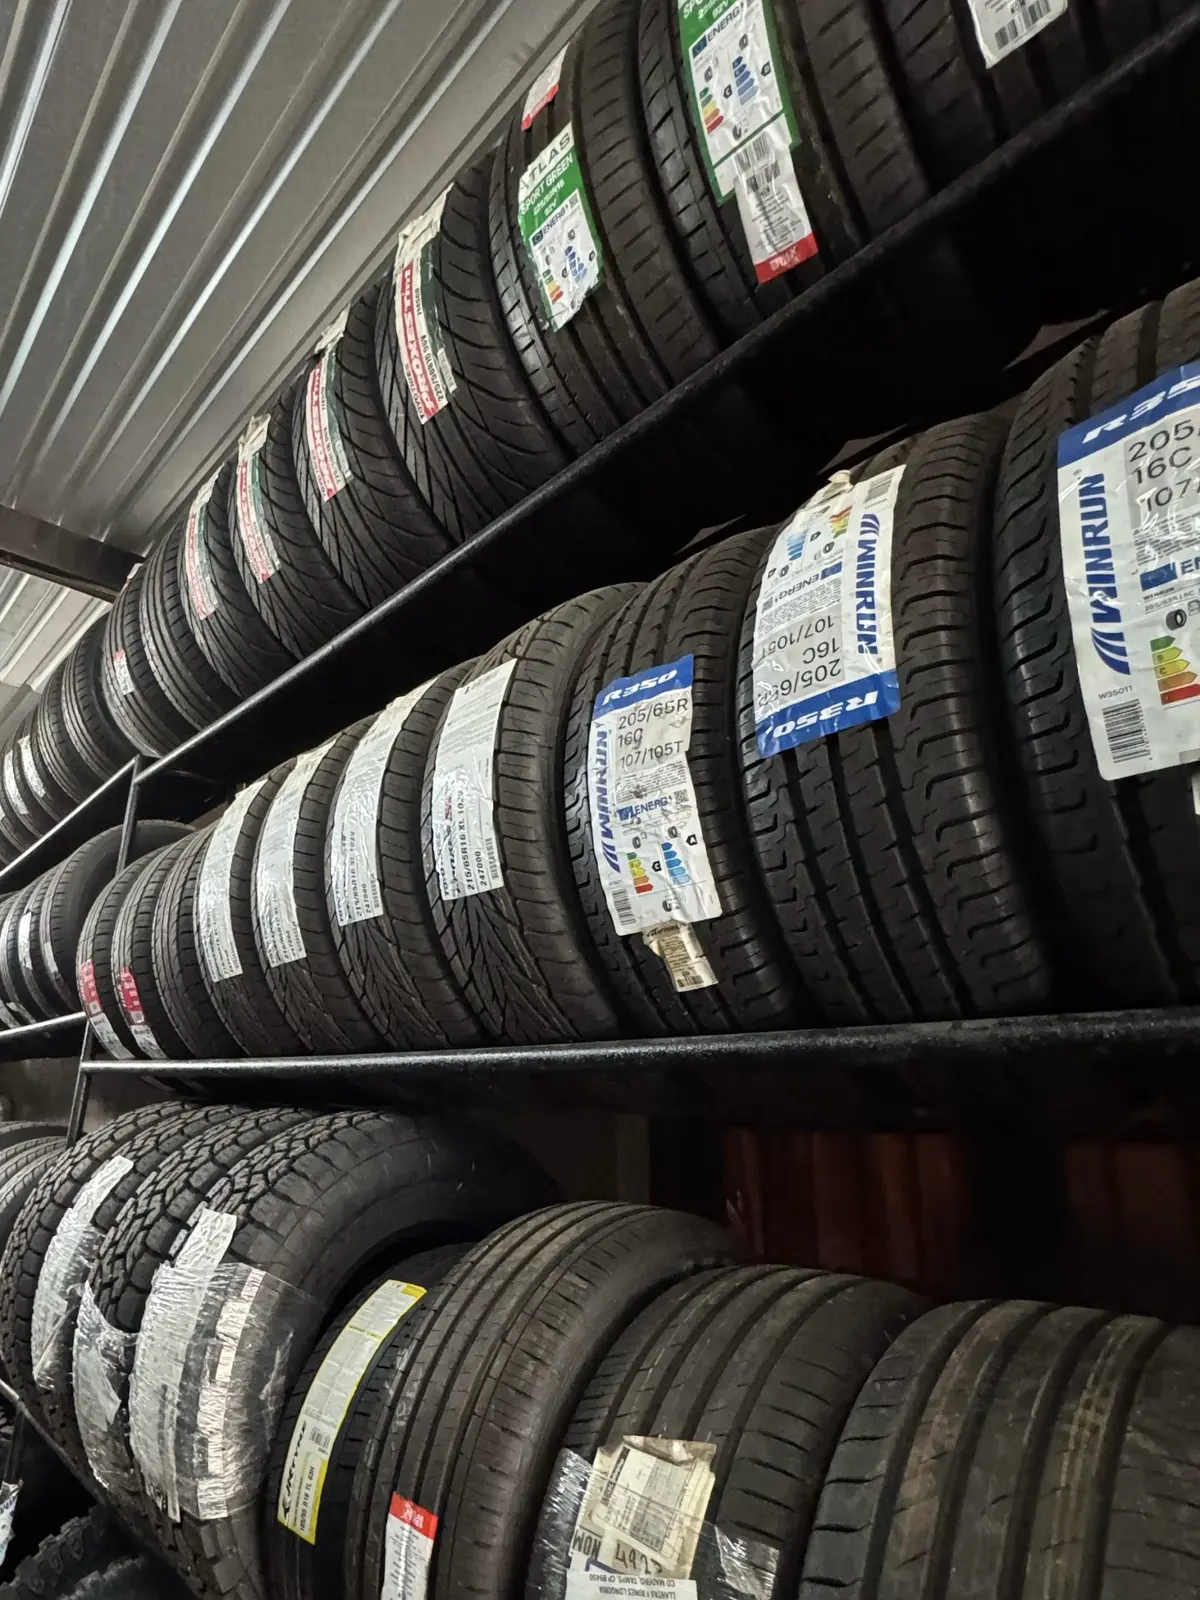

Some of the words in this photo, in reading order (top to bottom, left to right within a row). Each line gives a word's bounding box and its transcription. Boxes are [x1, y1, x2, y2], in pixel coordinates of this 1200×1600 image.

[707, 6, 740, 42] ENERG
[520, 181, 546, 215] SPORT
[546, 152, 573, 187] GREEN
[404, 312, 434, 415] PROXES
[1128, 419, 1200, 463] 205
[1131, 446, 1192, 484] 16C
[1079, 473, 1121, 623] WINRUN
[779, 573, 819, 599] ENERG
[855, 539, 879, 655] WINRUN
[802, 637, 840, 665] 16C
[602, 669, 678, 706] R350
[1098, 685, 1133, 700] W35011
[618, 698, 688, 730] 205/65R
[773, 690, 879, 738] R350
[620, 740, 684, 769] 107/105T
[634, 799, 669, 817] ENERG
[460, 834, 475, 891] 215/65R16
[475, 850, 487, 887] 247000
[572, 1529, 602, 1560] NOM
